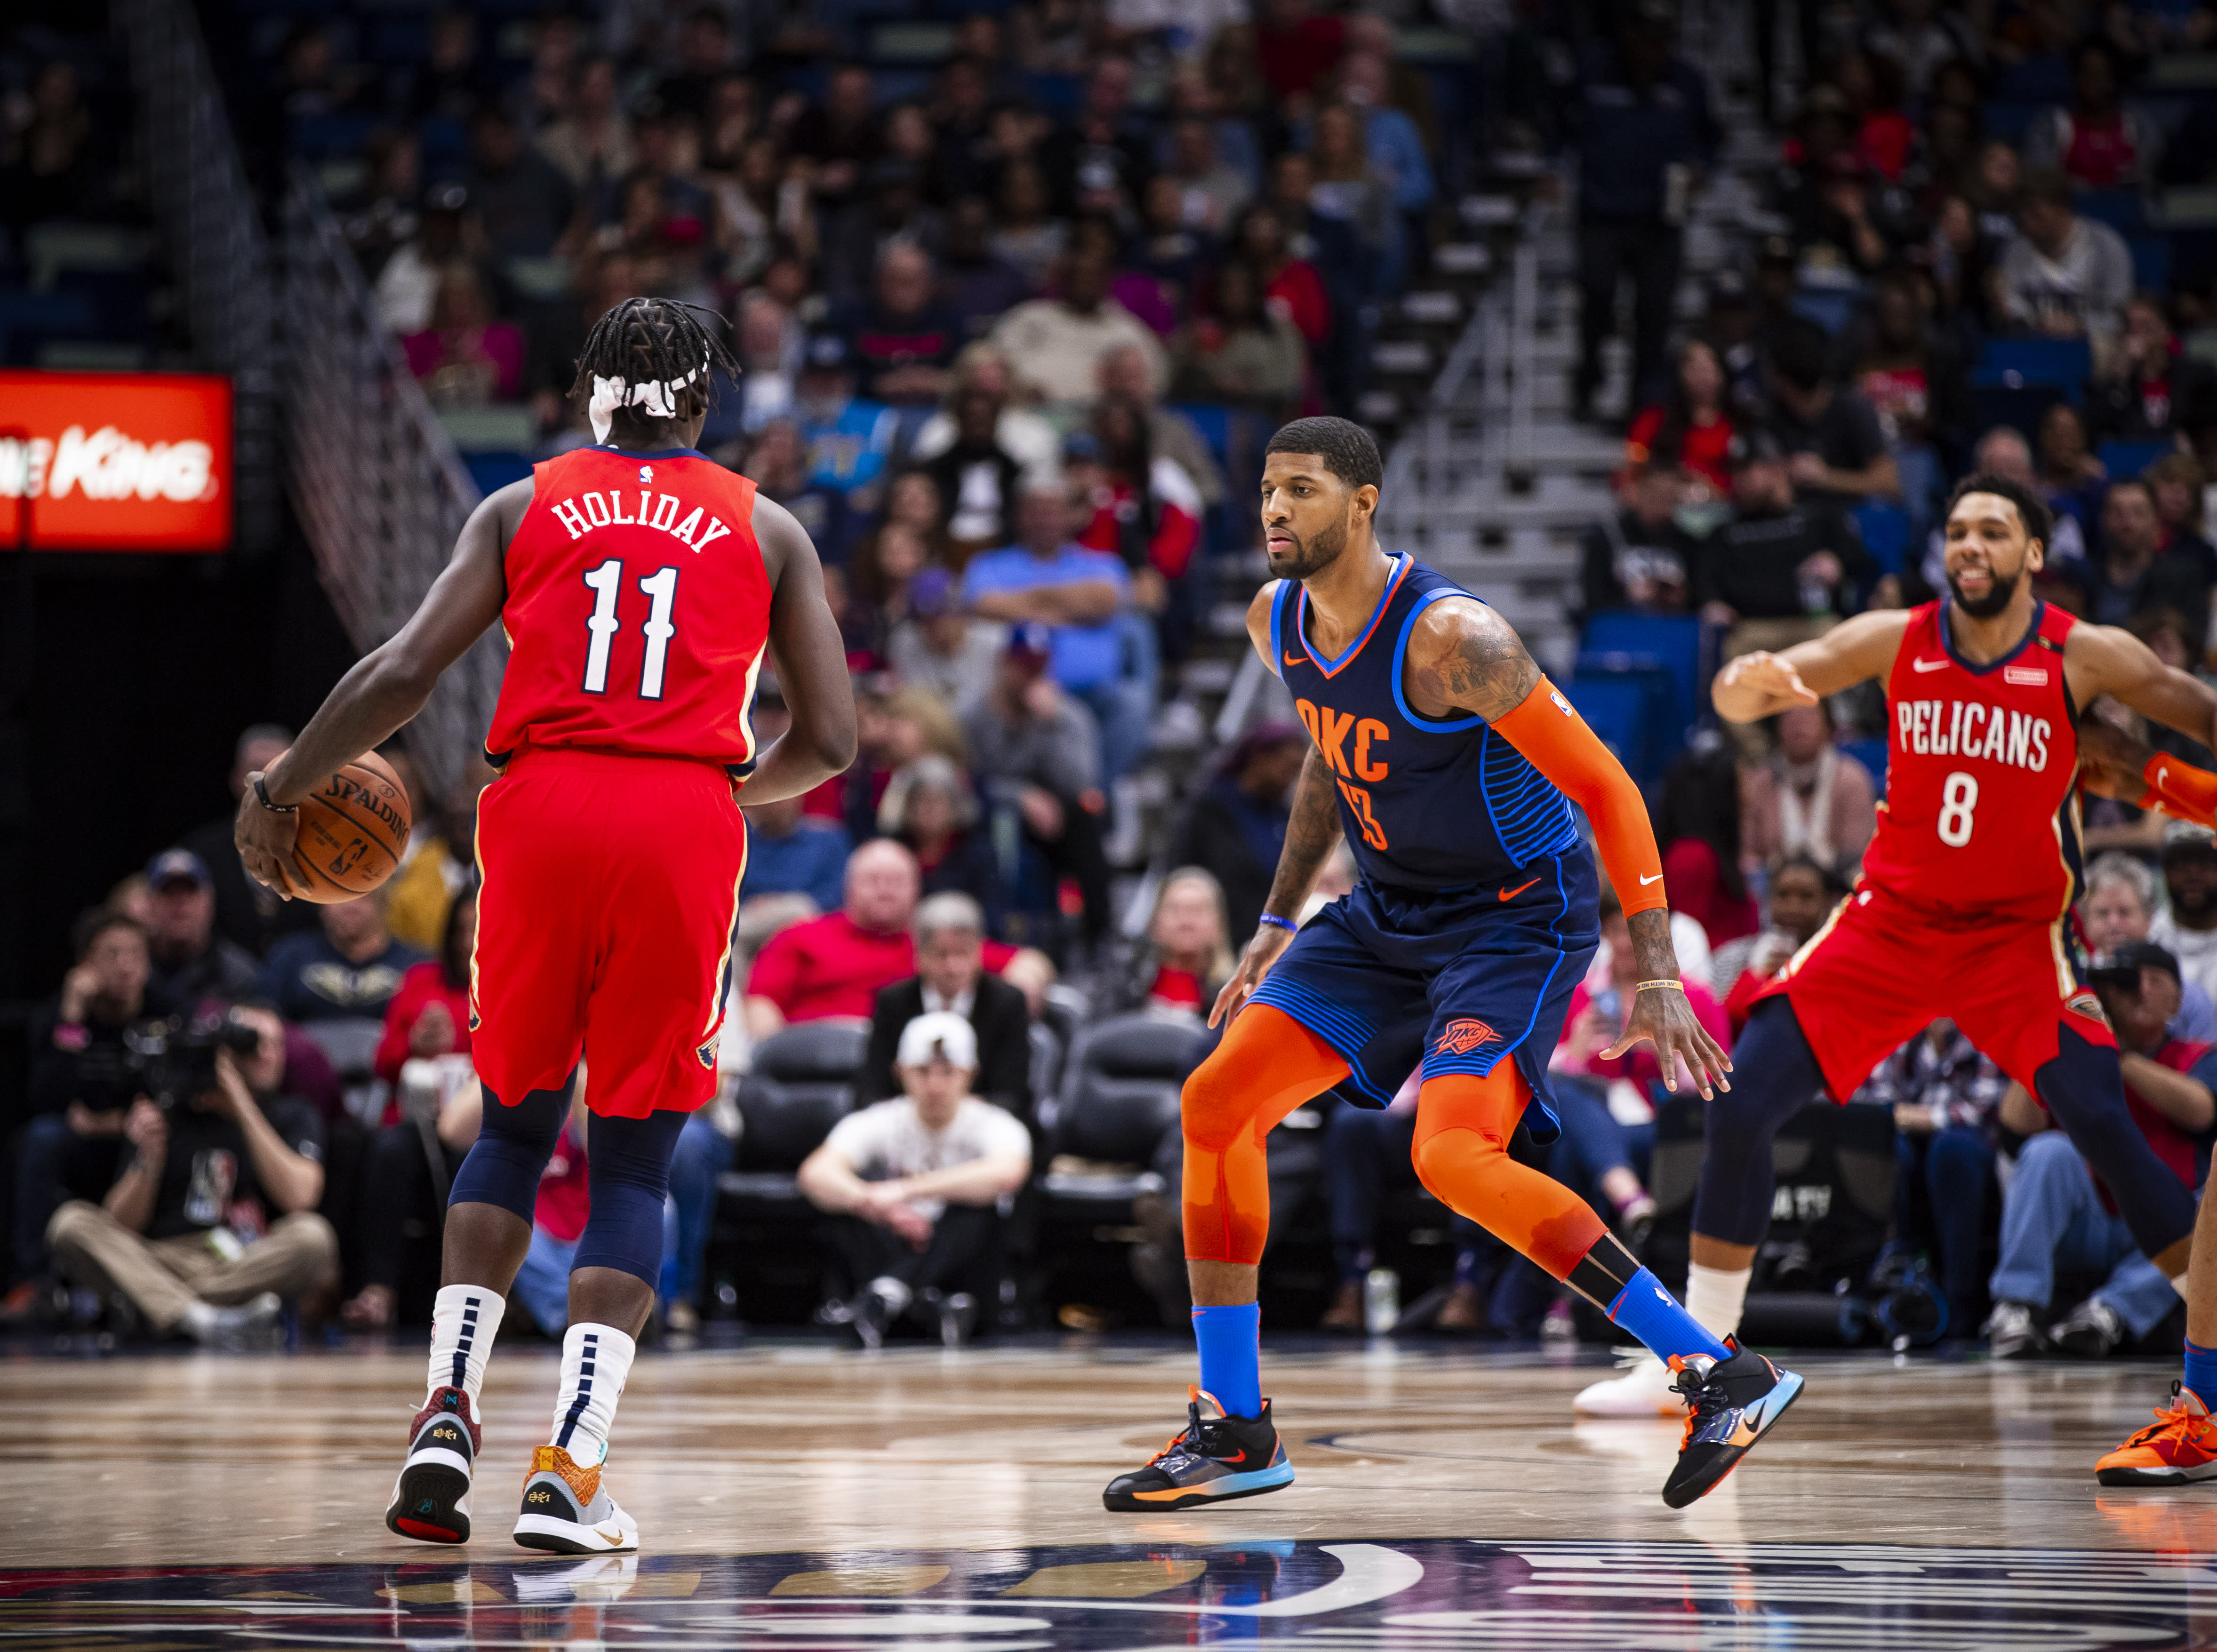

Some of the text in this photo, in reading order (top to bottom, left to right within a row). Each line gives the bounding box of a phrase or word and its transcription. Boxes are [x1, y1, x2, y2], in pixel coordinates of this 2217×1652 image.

[551, 490, 731, 553] HOLIDAY
[581, 557, 681, 701] 11
[1897, 699, 2051, 773] PELICANS
[1937, 771, 1979, 848] 8
